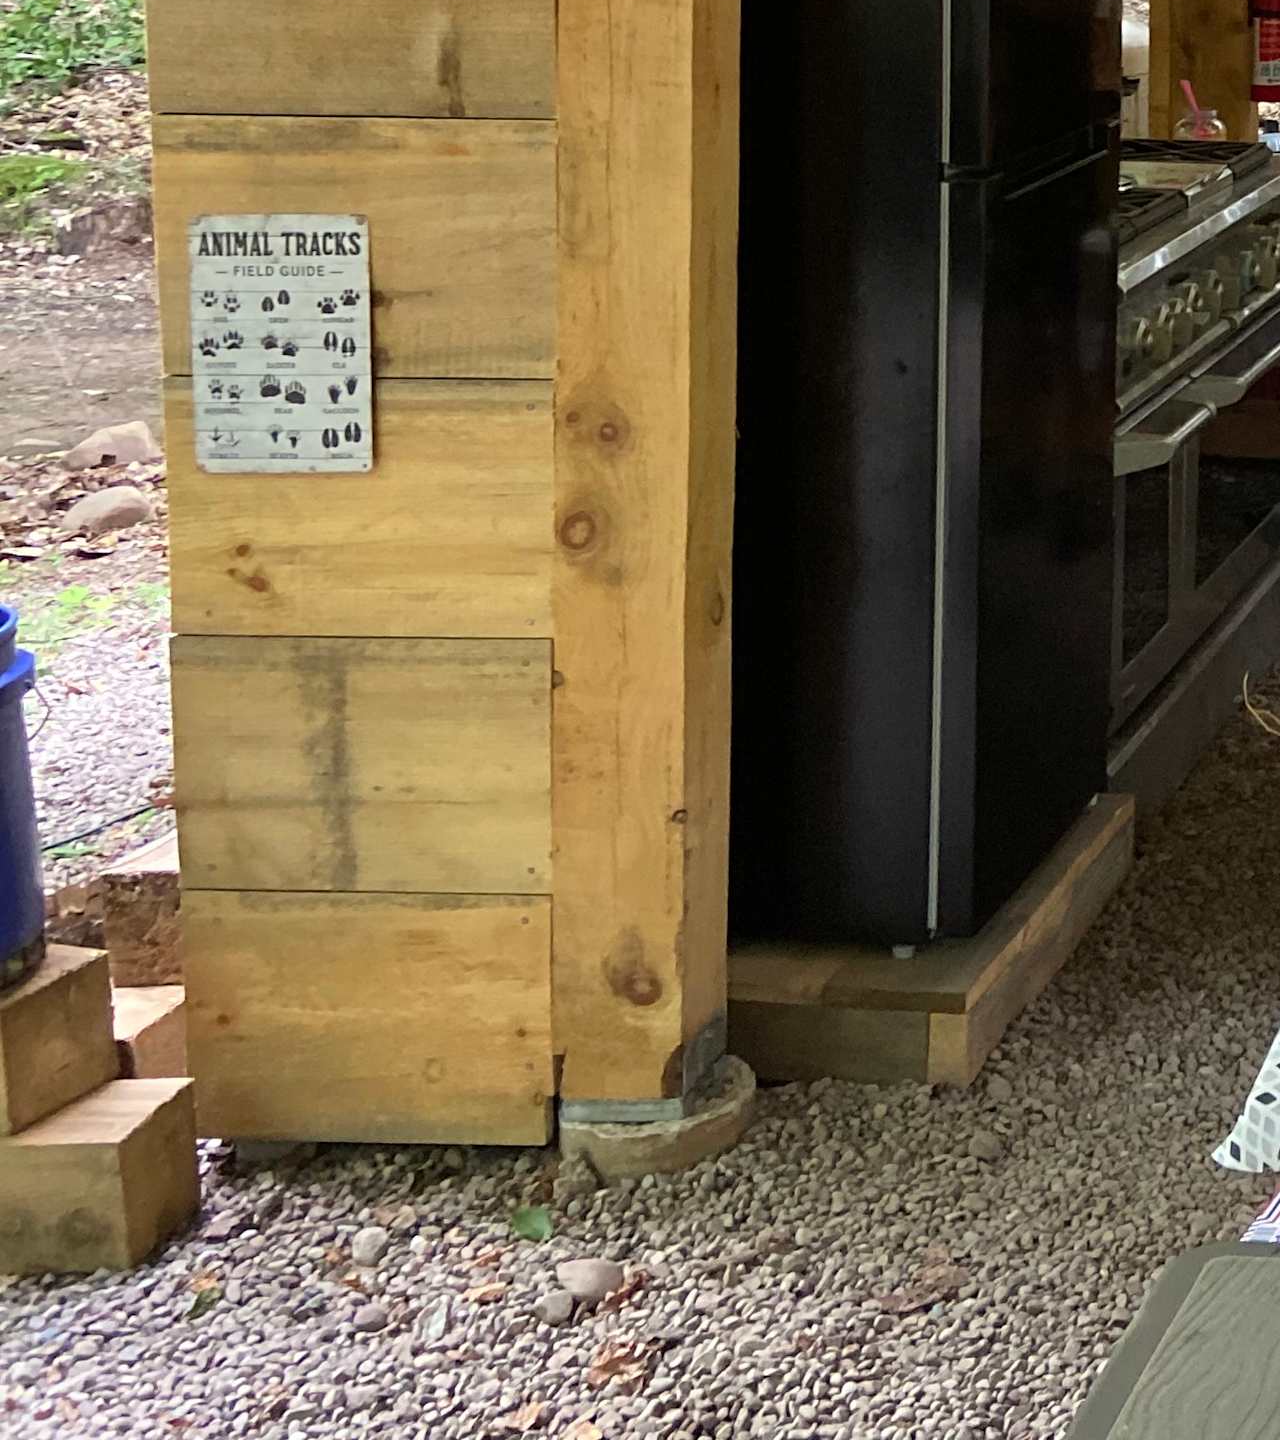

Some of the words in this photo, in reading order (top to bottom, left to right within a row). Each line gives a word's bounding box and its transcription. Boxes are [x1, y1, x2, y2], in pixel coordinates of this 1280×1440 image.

[198, 231, 274, 257] ANIMAL
[281, 231, 361, 257] TRACKS
[233, 265, 274, 278] FIELD
[280, 265, 325, 278] GUIDE
